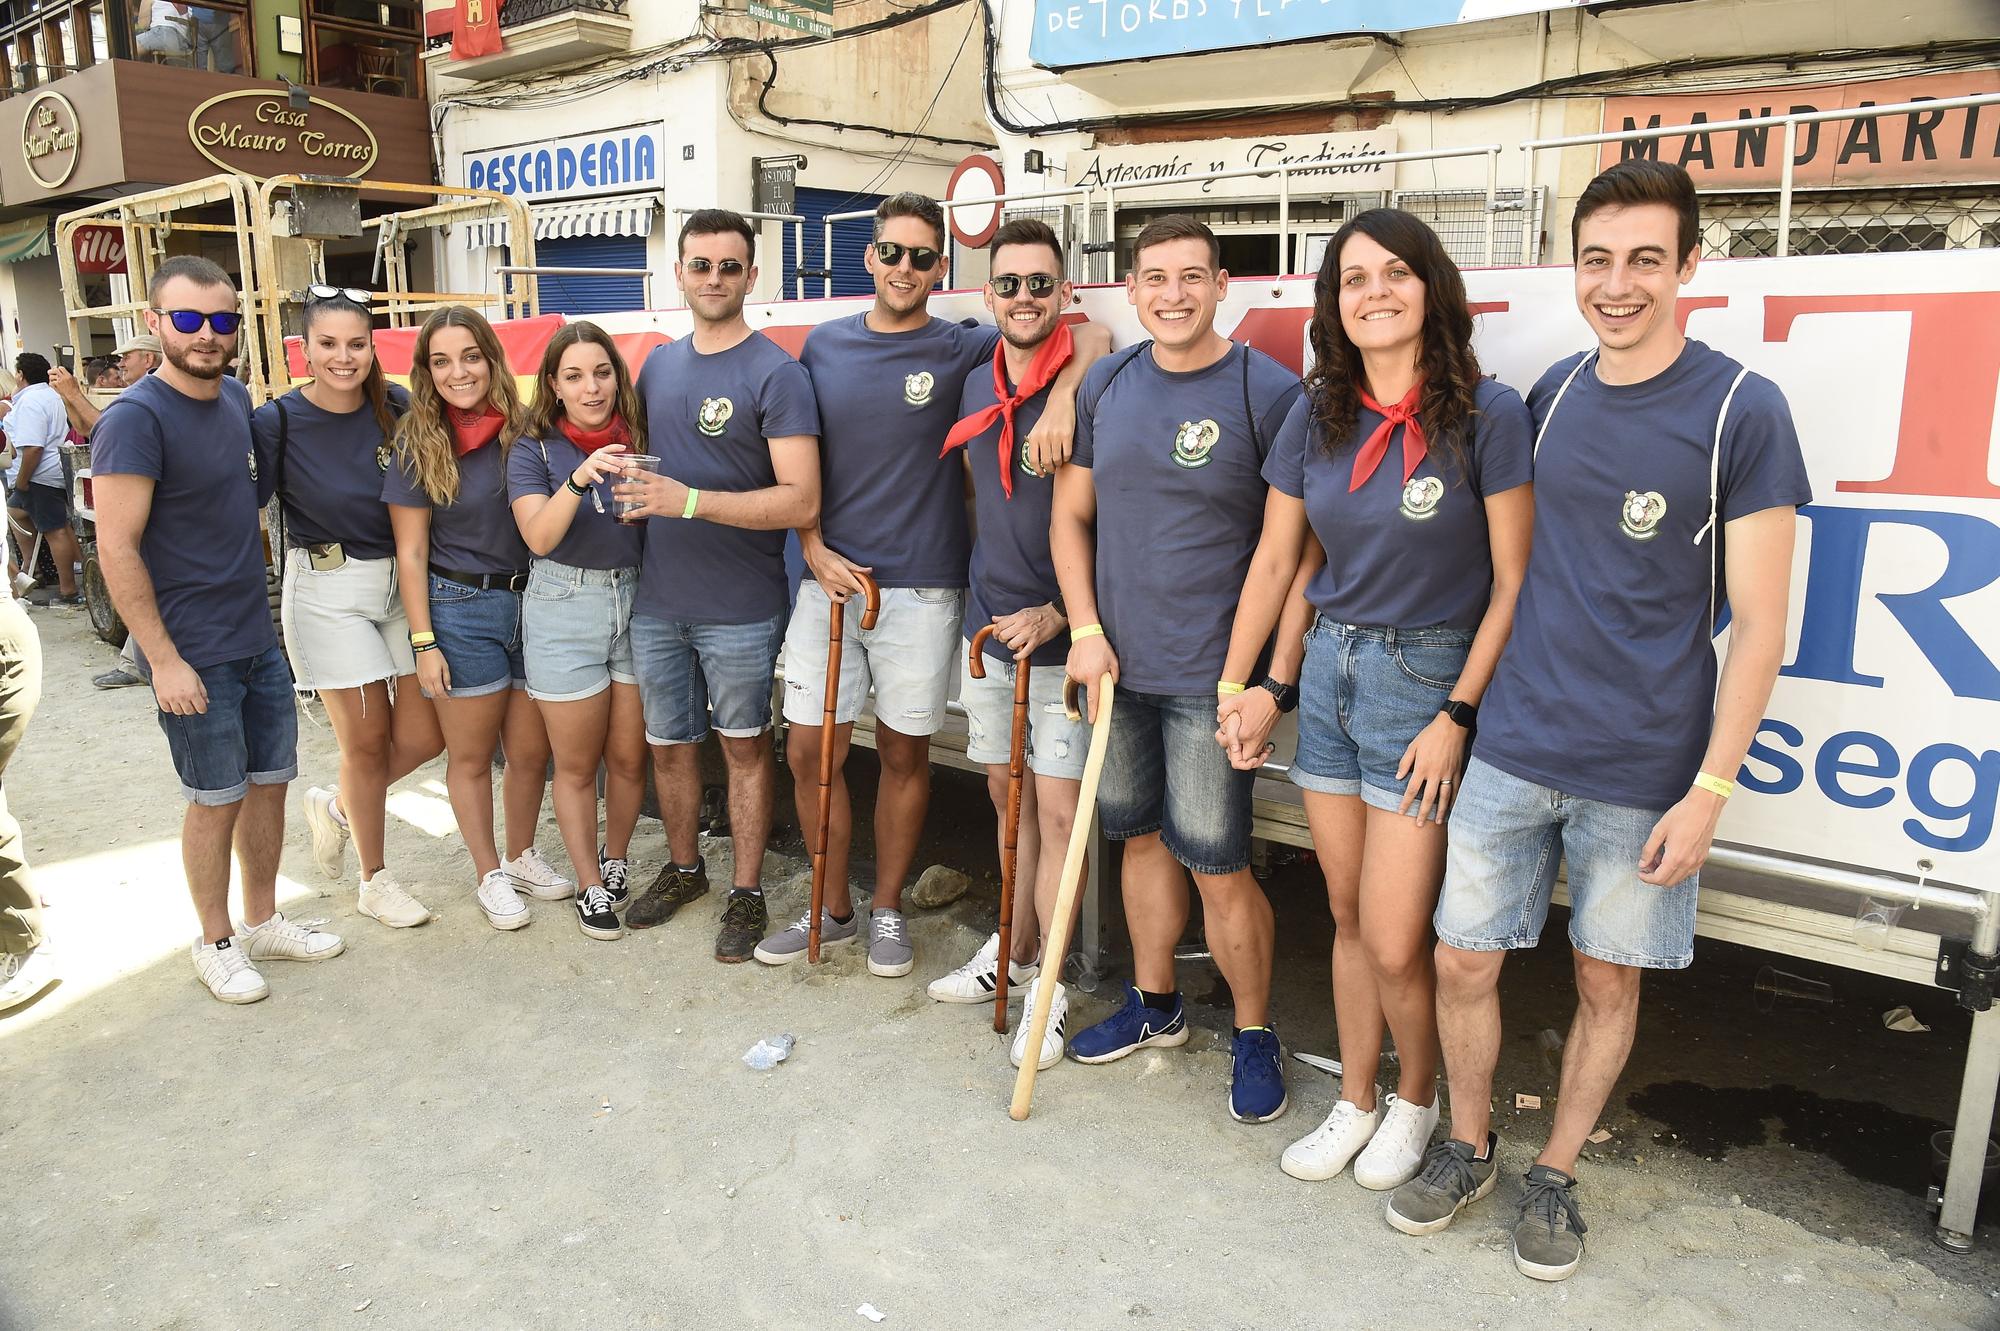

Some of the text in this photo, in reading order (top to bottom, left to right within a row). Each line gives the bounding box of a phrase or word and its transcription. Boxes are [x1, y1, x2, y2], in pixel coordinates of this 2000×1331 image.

[749, 4, 774, 21] BODEGA
[776, 11, 790, 25] BAR
[1048, 6, 1084, 32] DE
[256, 100, 308, 128] Casa
[198, 121, 371, 161] Mauro Torres
[1619, 92, 2000, 172] MANDARI
[469, 134, 655, 200] PESCADERIA
[763, 168, 792, 184] ASADOR
[1201, 160, 1225, 193] y
[773, 184, 783, 199] EL
[79, 230, 127, 271] illy
